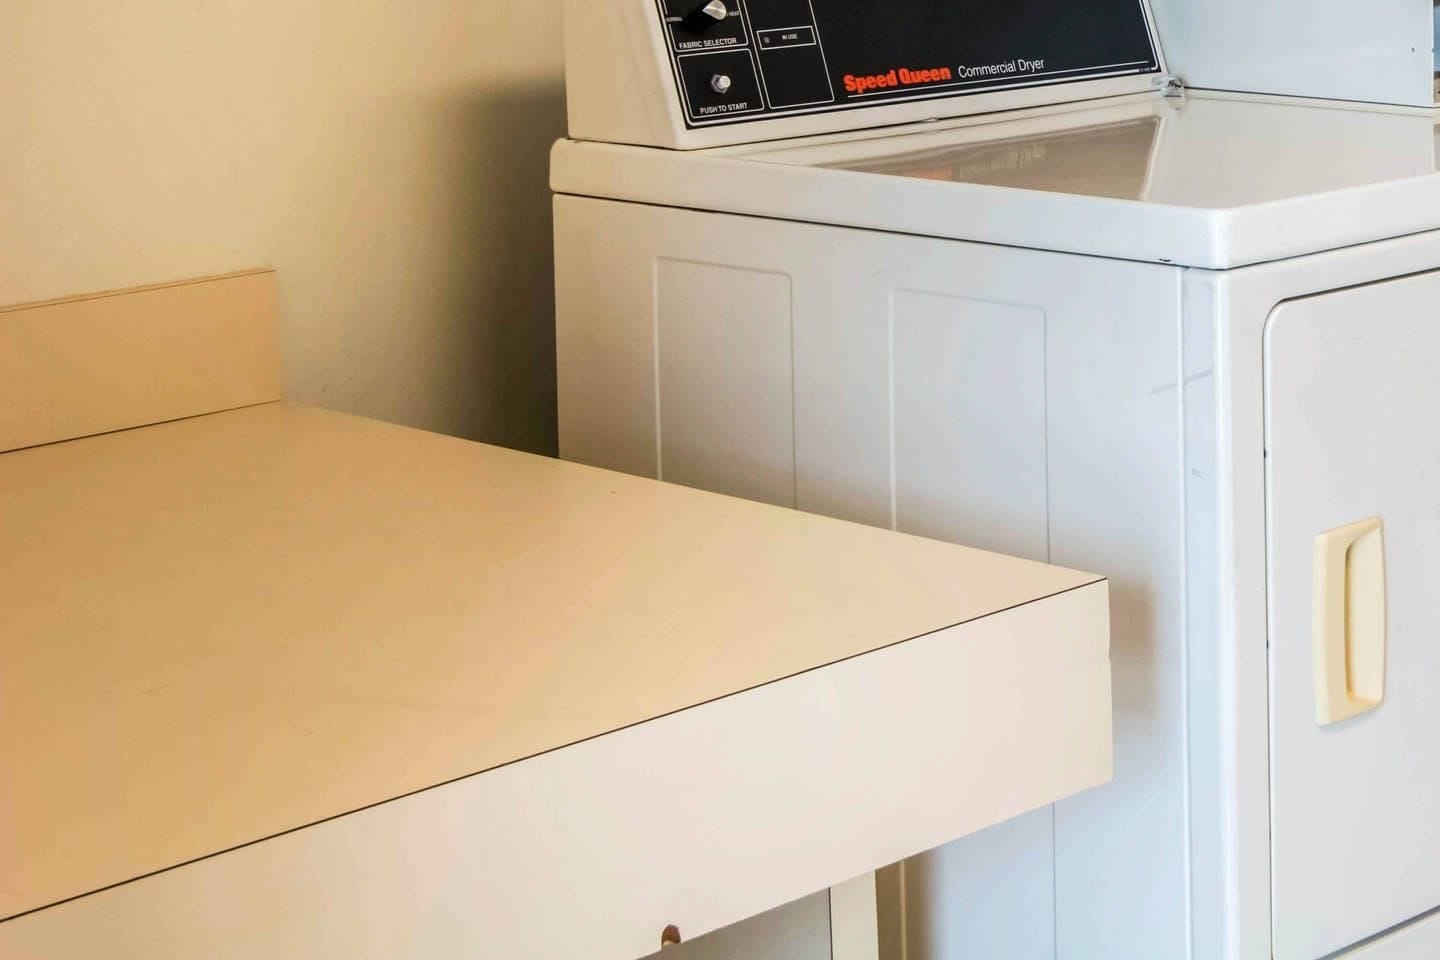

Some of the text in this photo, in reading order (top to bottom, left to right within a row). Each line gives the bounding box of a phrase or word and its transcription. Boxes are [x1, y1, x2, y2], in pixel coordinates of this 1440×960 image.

[679, 37, 737, 49] FABRIC SELECTOR
[843, 58, 1045, 94] Speed Queen Commercial Dryer
[700, 102, 748, 114] PUSH TO START
